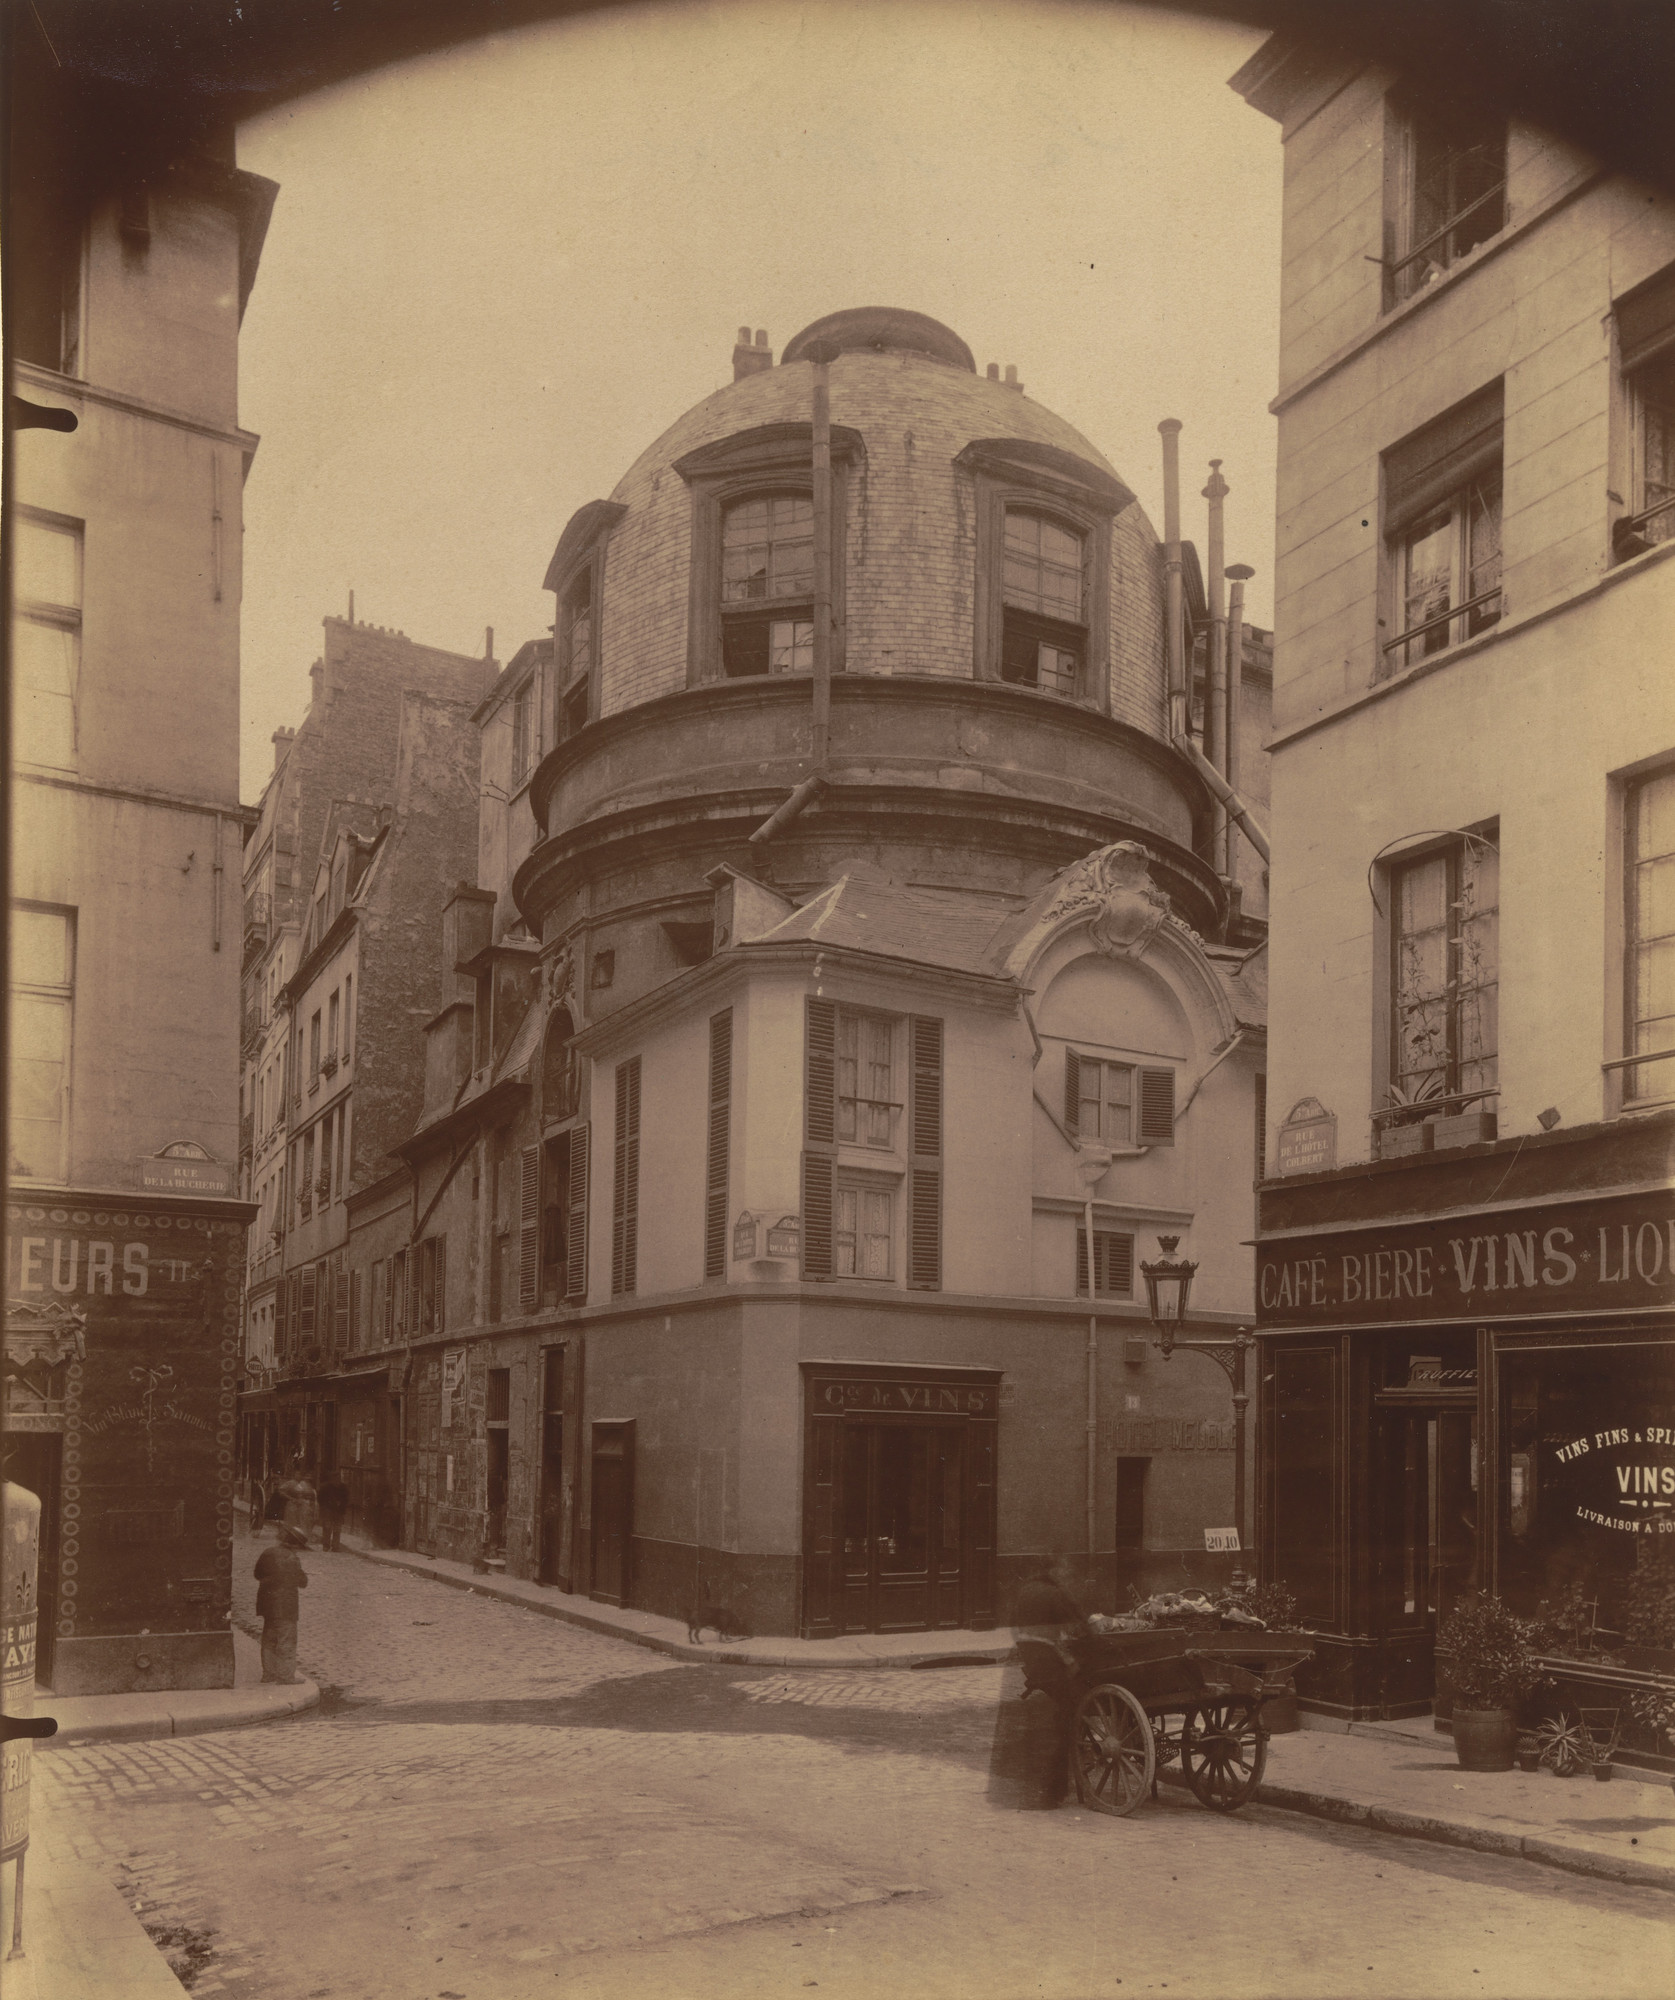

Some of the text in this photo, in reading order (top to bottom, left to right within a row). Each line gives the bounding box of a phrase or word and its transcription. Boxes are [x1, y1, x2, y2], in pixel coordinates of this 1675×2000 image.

[1295, 1130, 1315, 1142] RUE
[1281, 1145, 1293, 1157] DE
[1286, 1152, 1325, 1168] COLBERT
[173, 1167, 199, 1178] RUE
[143, 1176, 227, 1192] DE LA BUCHERIE
[6, 1236, 150, 1296] EURS
[1340, 1244, 1434, 1304] BIÈRE
[1447, 1226, 1578, 1293] VINS
[1417, 1370, 1478, 1380] RUFFIE
[899, 1387, 984, 1411] VINS
[1555, 1426, 1675, 1464] VINS FINS & SPI
[1615, 1465, 1675, 1495] VINS
[1576, 1505, 1675, 1534] LIVRAISON A DO
